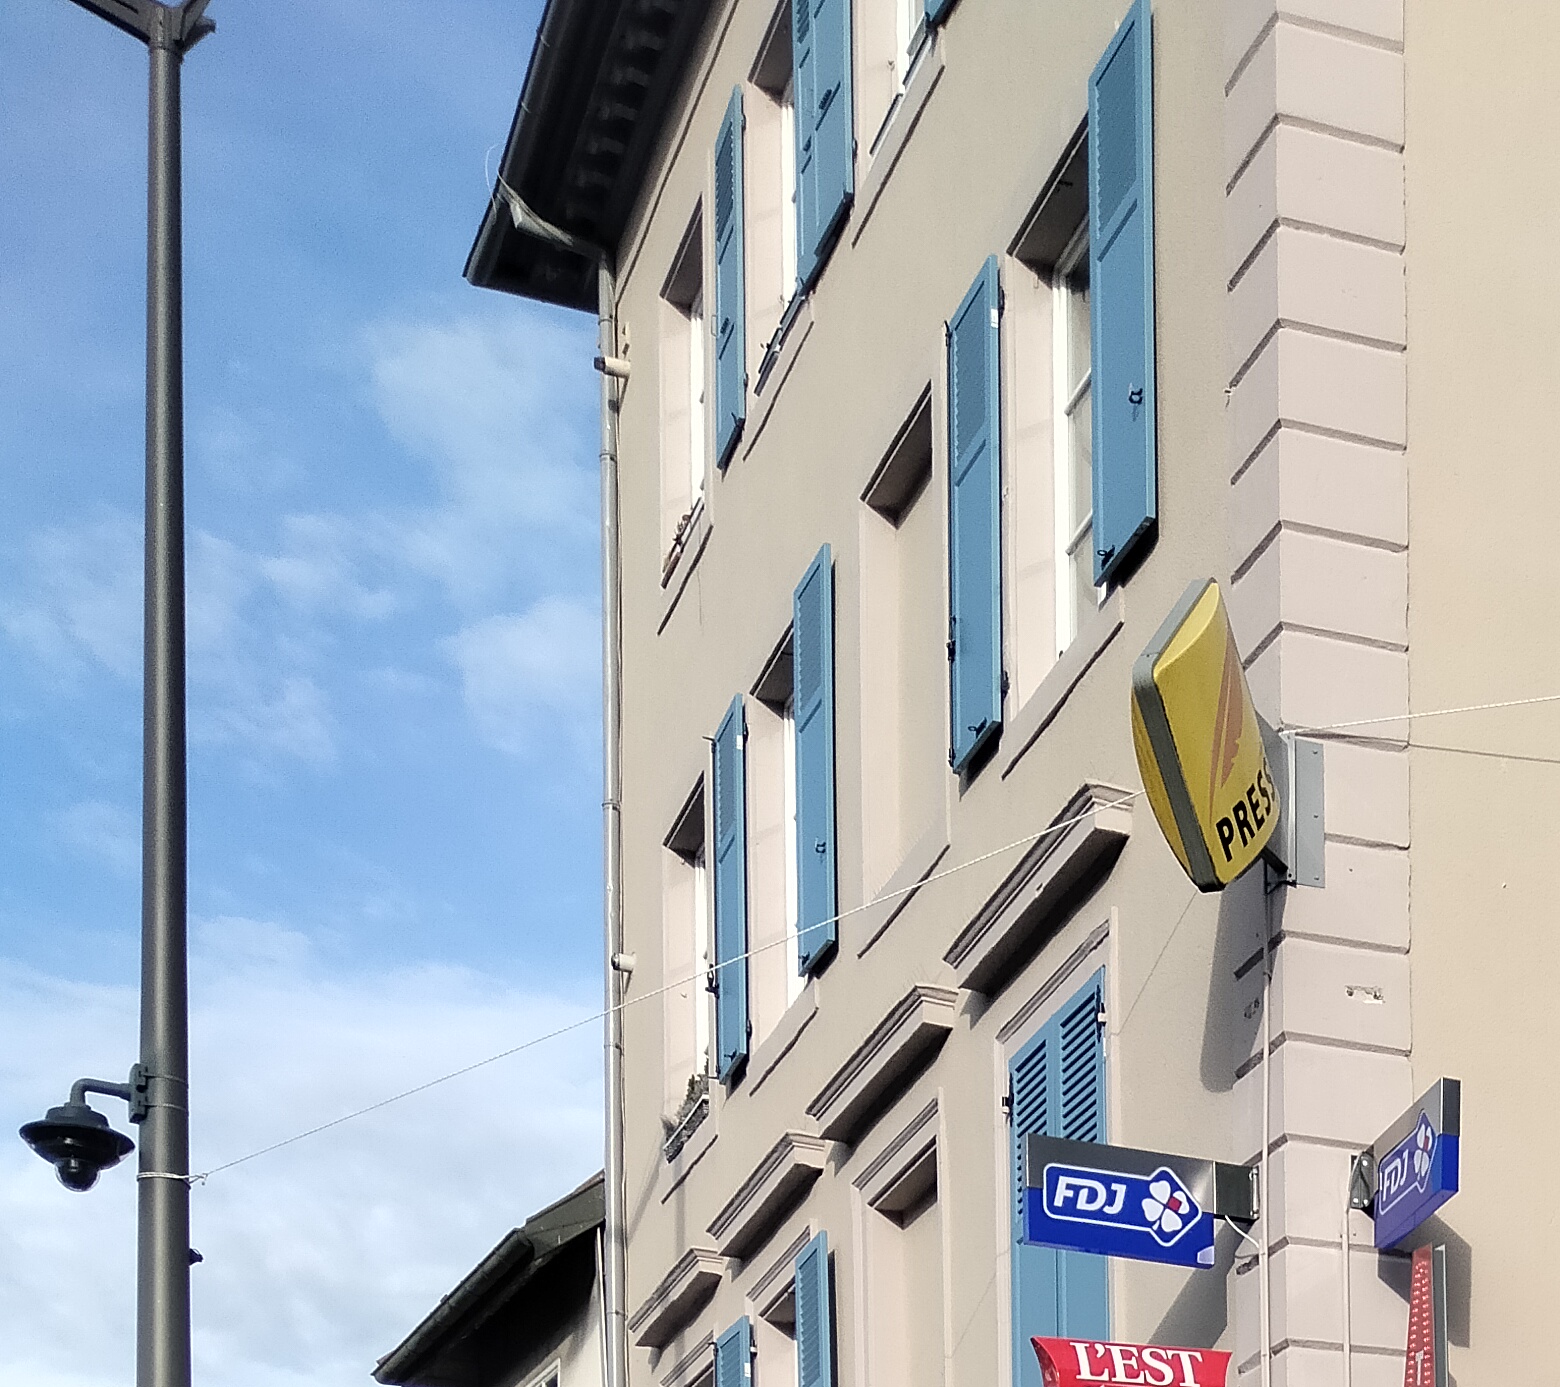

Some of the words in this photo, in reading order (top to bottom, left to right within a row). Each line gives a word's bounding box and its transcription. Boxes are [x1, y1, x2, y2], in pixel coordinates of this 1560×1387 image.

[1053, 1175, 1126, 1215] FDJ
[1383, 1149, 1409, 1202] FDJ
[1070, 1341, 1203, 1387] L'EST
